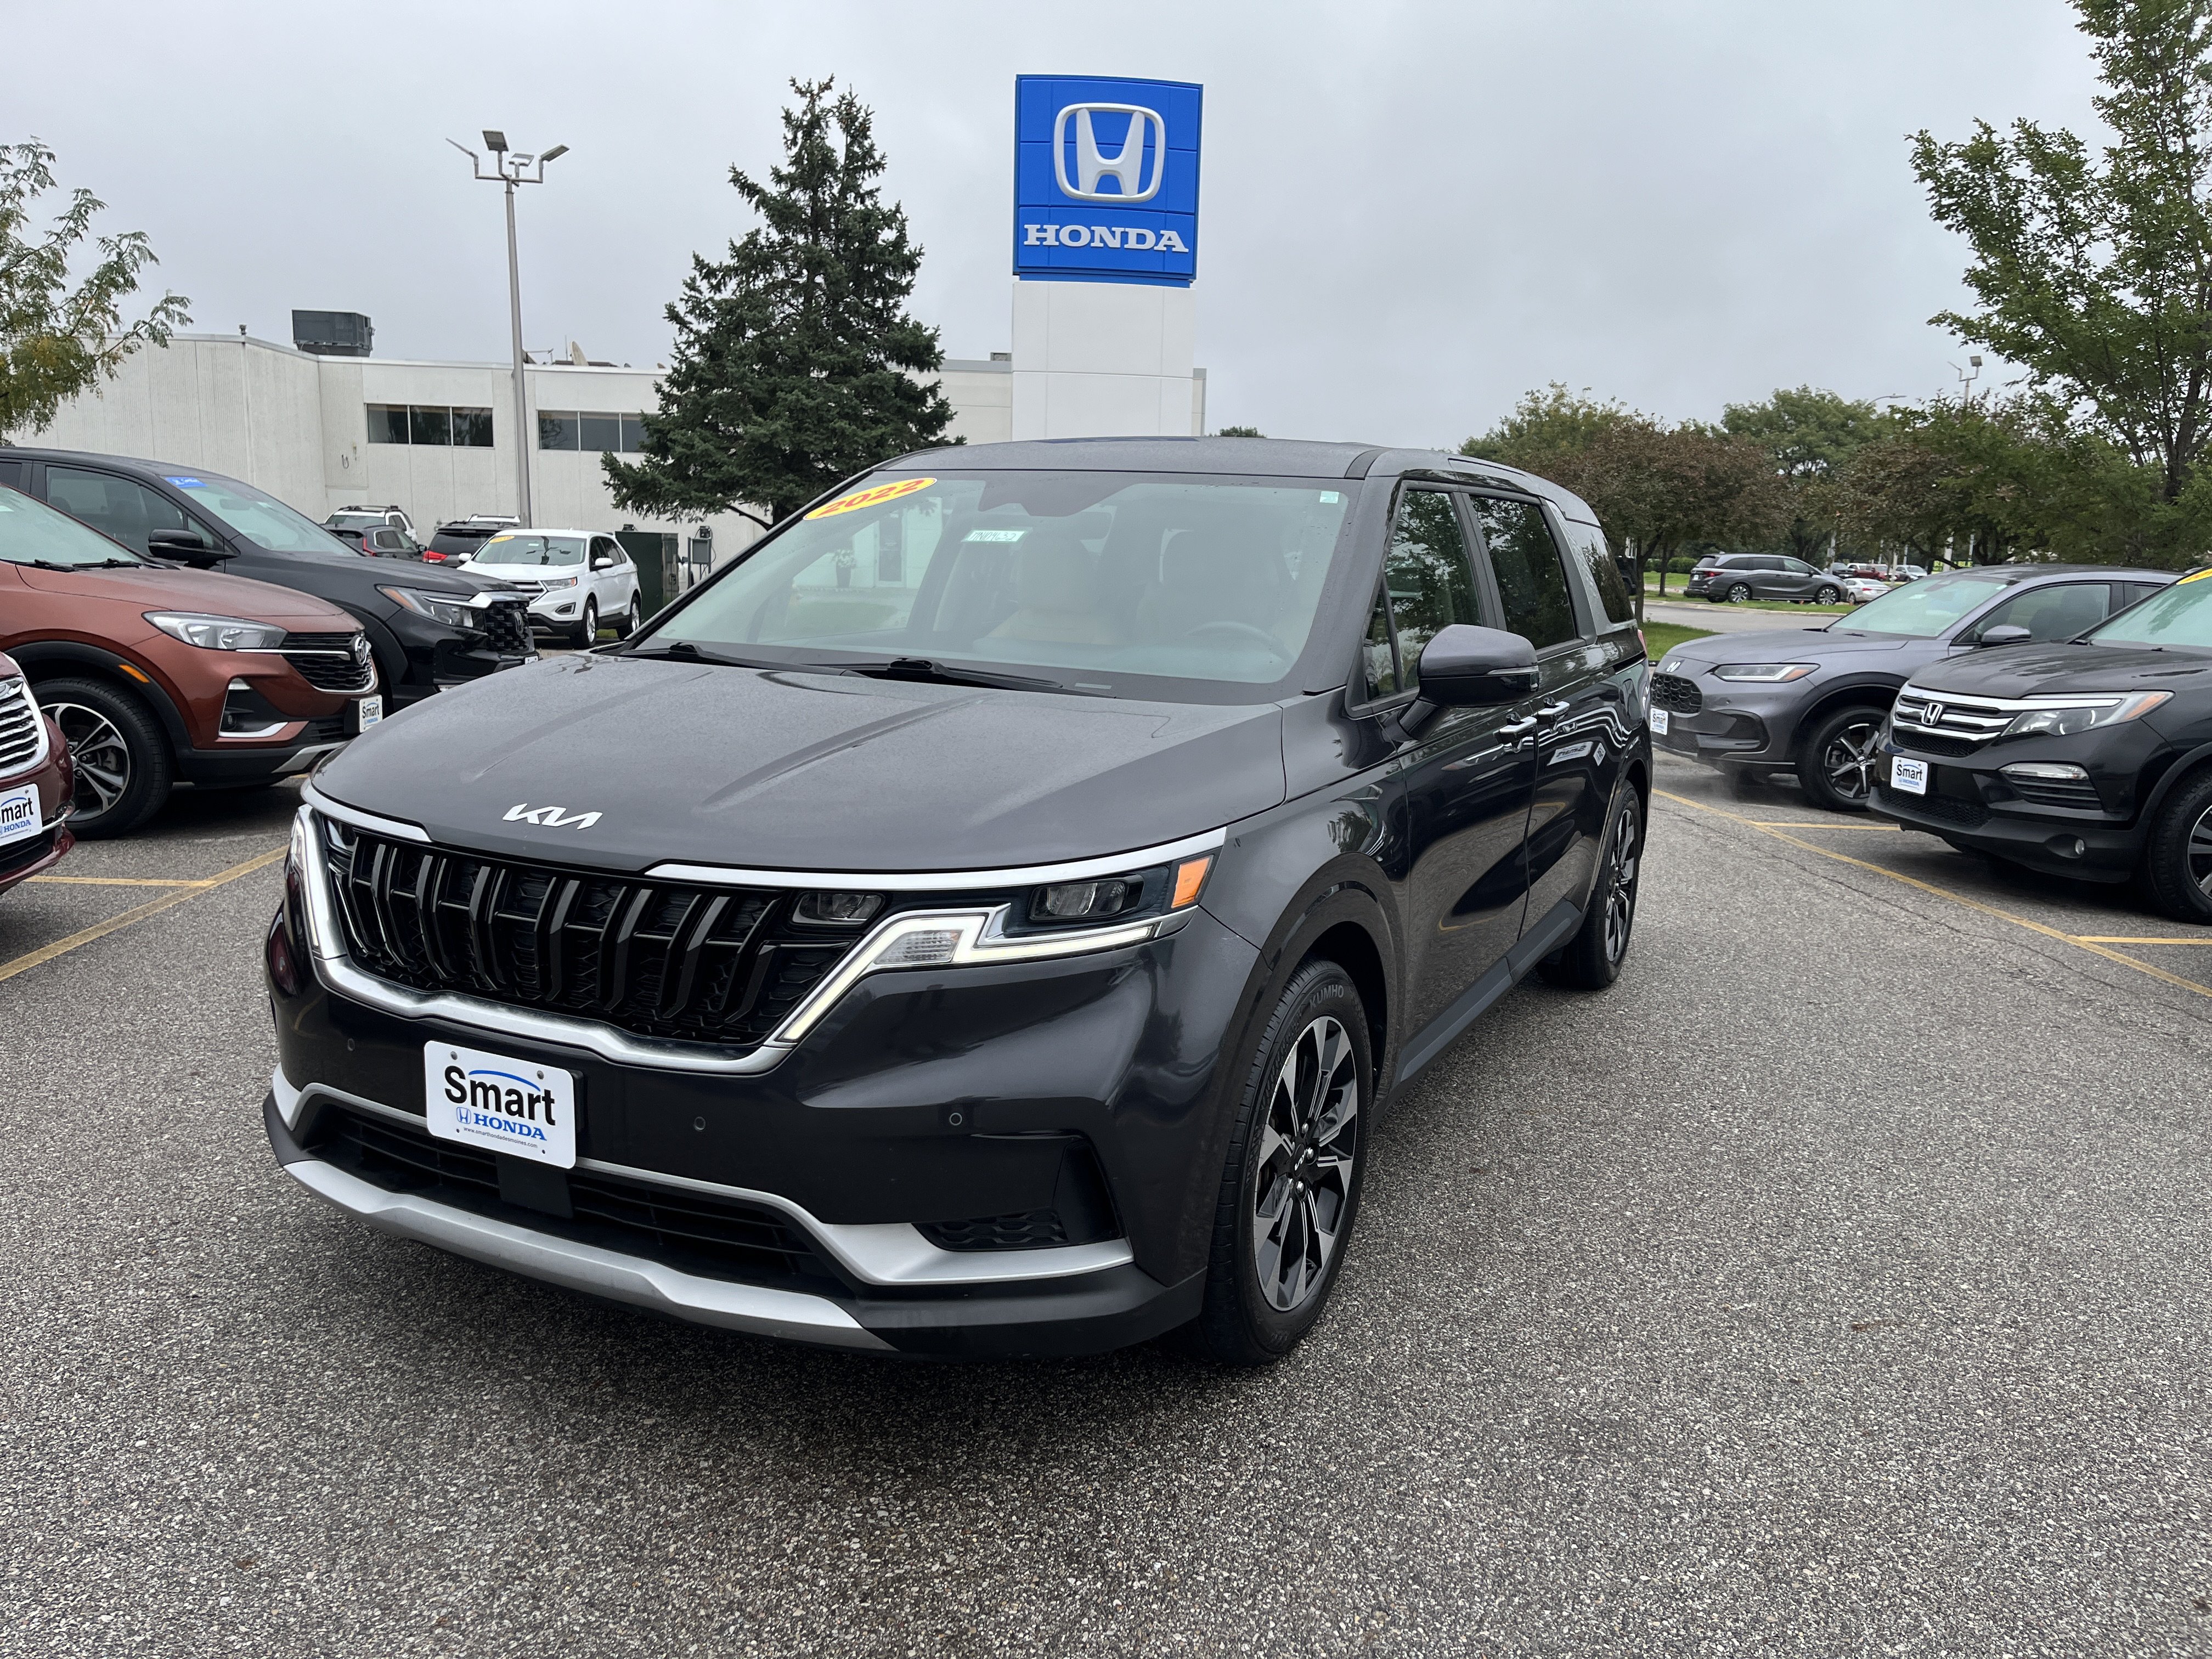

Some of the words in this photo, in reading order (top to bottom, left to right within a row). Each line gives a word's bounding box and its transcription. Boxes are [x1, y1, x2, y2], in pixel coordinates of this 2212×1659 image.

[1024, 224, 1189, 253] HONDA
[816, 479, 924, 517] 2022
[362, 703, 380, 719] Smart
[1897, 764, 1922, 781] Smart
[0, 797, 33, 823] mart
[502, 803, 603, 830] KIA
[4, 819, 31, 833] HONDA
[1309, 984, 1344, 1011] KUMHO
[444, 1065, 556, 1126] Smart
[463, 1127, 538, 1148] www.smarthondadesmoines.com
[473, 1113, 548, 1141] HONDA
